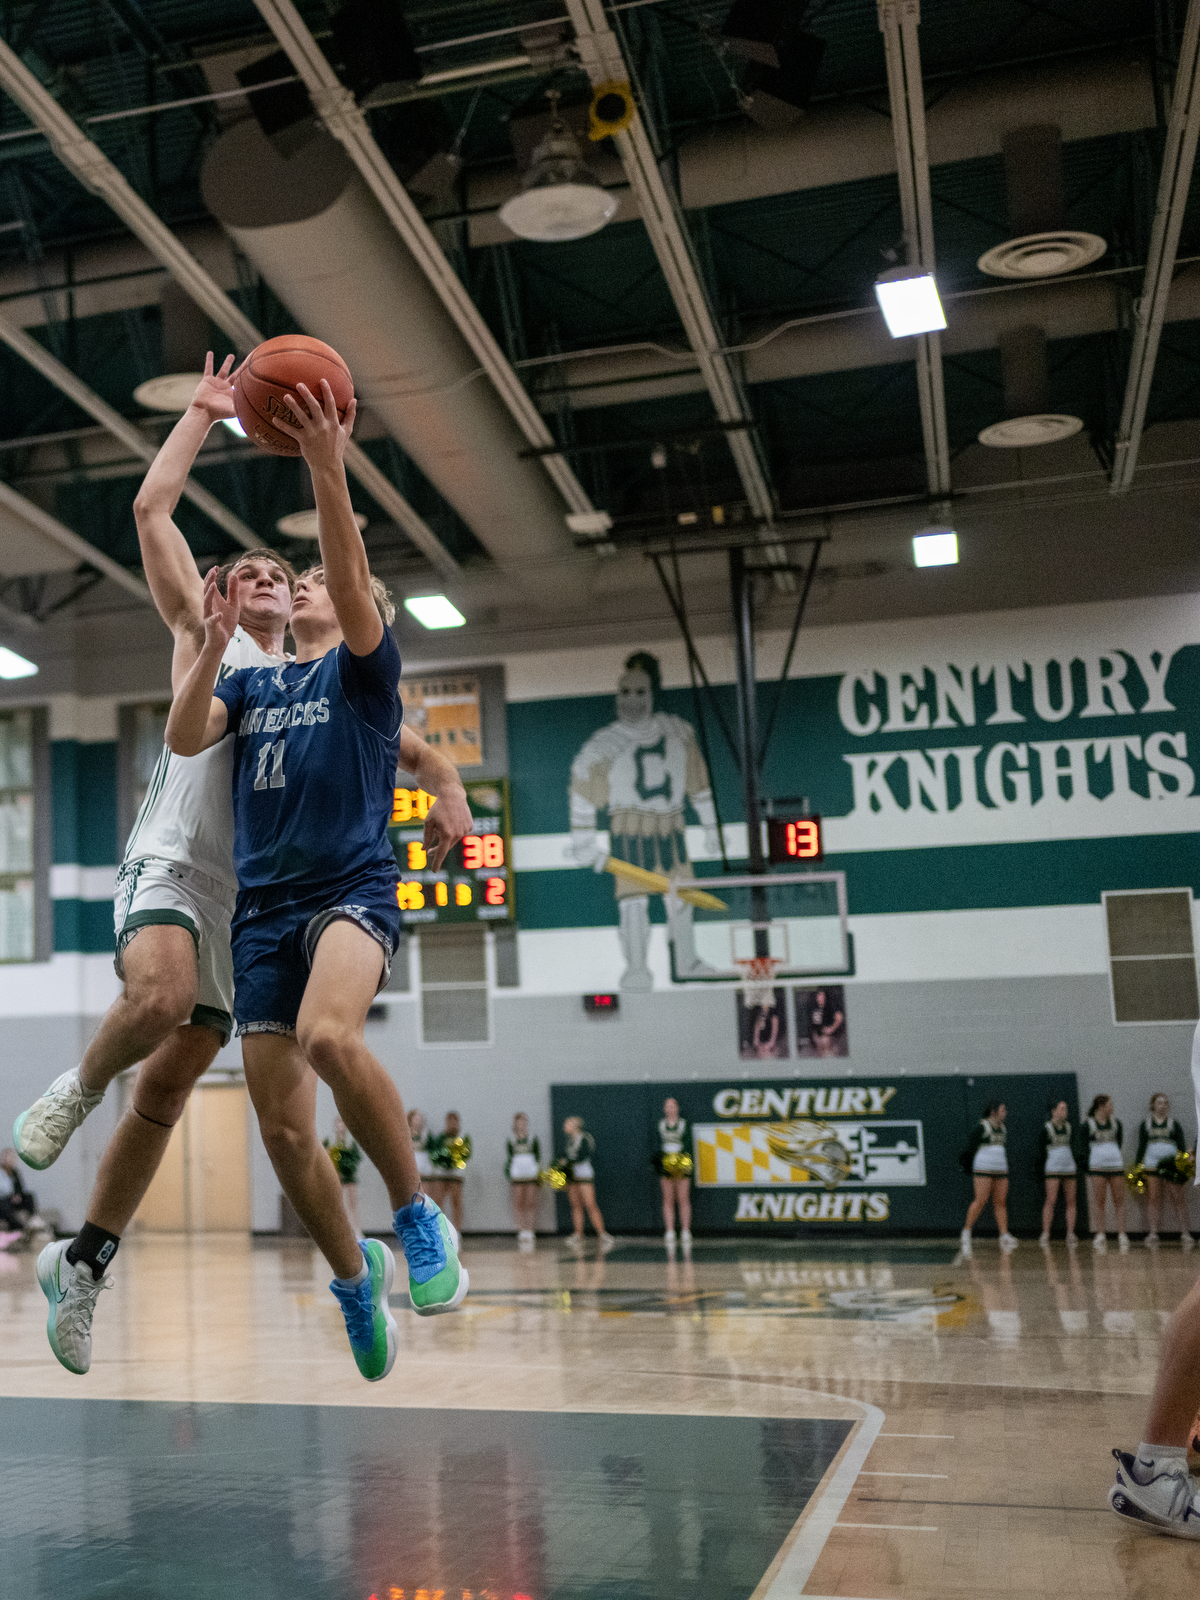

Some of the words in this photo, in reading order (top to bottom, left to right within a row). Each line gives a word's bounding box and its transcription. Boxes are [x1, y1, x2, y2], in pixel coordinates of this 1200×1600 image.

[837, 646, 1178, 737] CENTURY
[254, 739, 286, 791] 11
[634, 735, 672, 800] C
[843, 731, 1196, 816] KNIGHTS
[463, 834, 504, 869] 38
[785, 820, 819, 858] 13
[486, 877, 506, 905] 2
[713, 1086, 896, 1121] CENTURY
[735, 1192, 890, 1222] KNIGHTS
